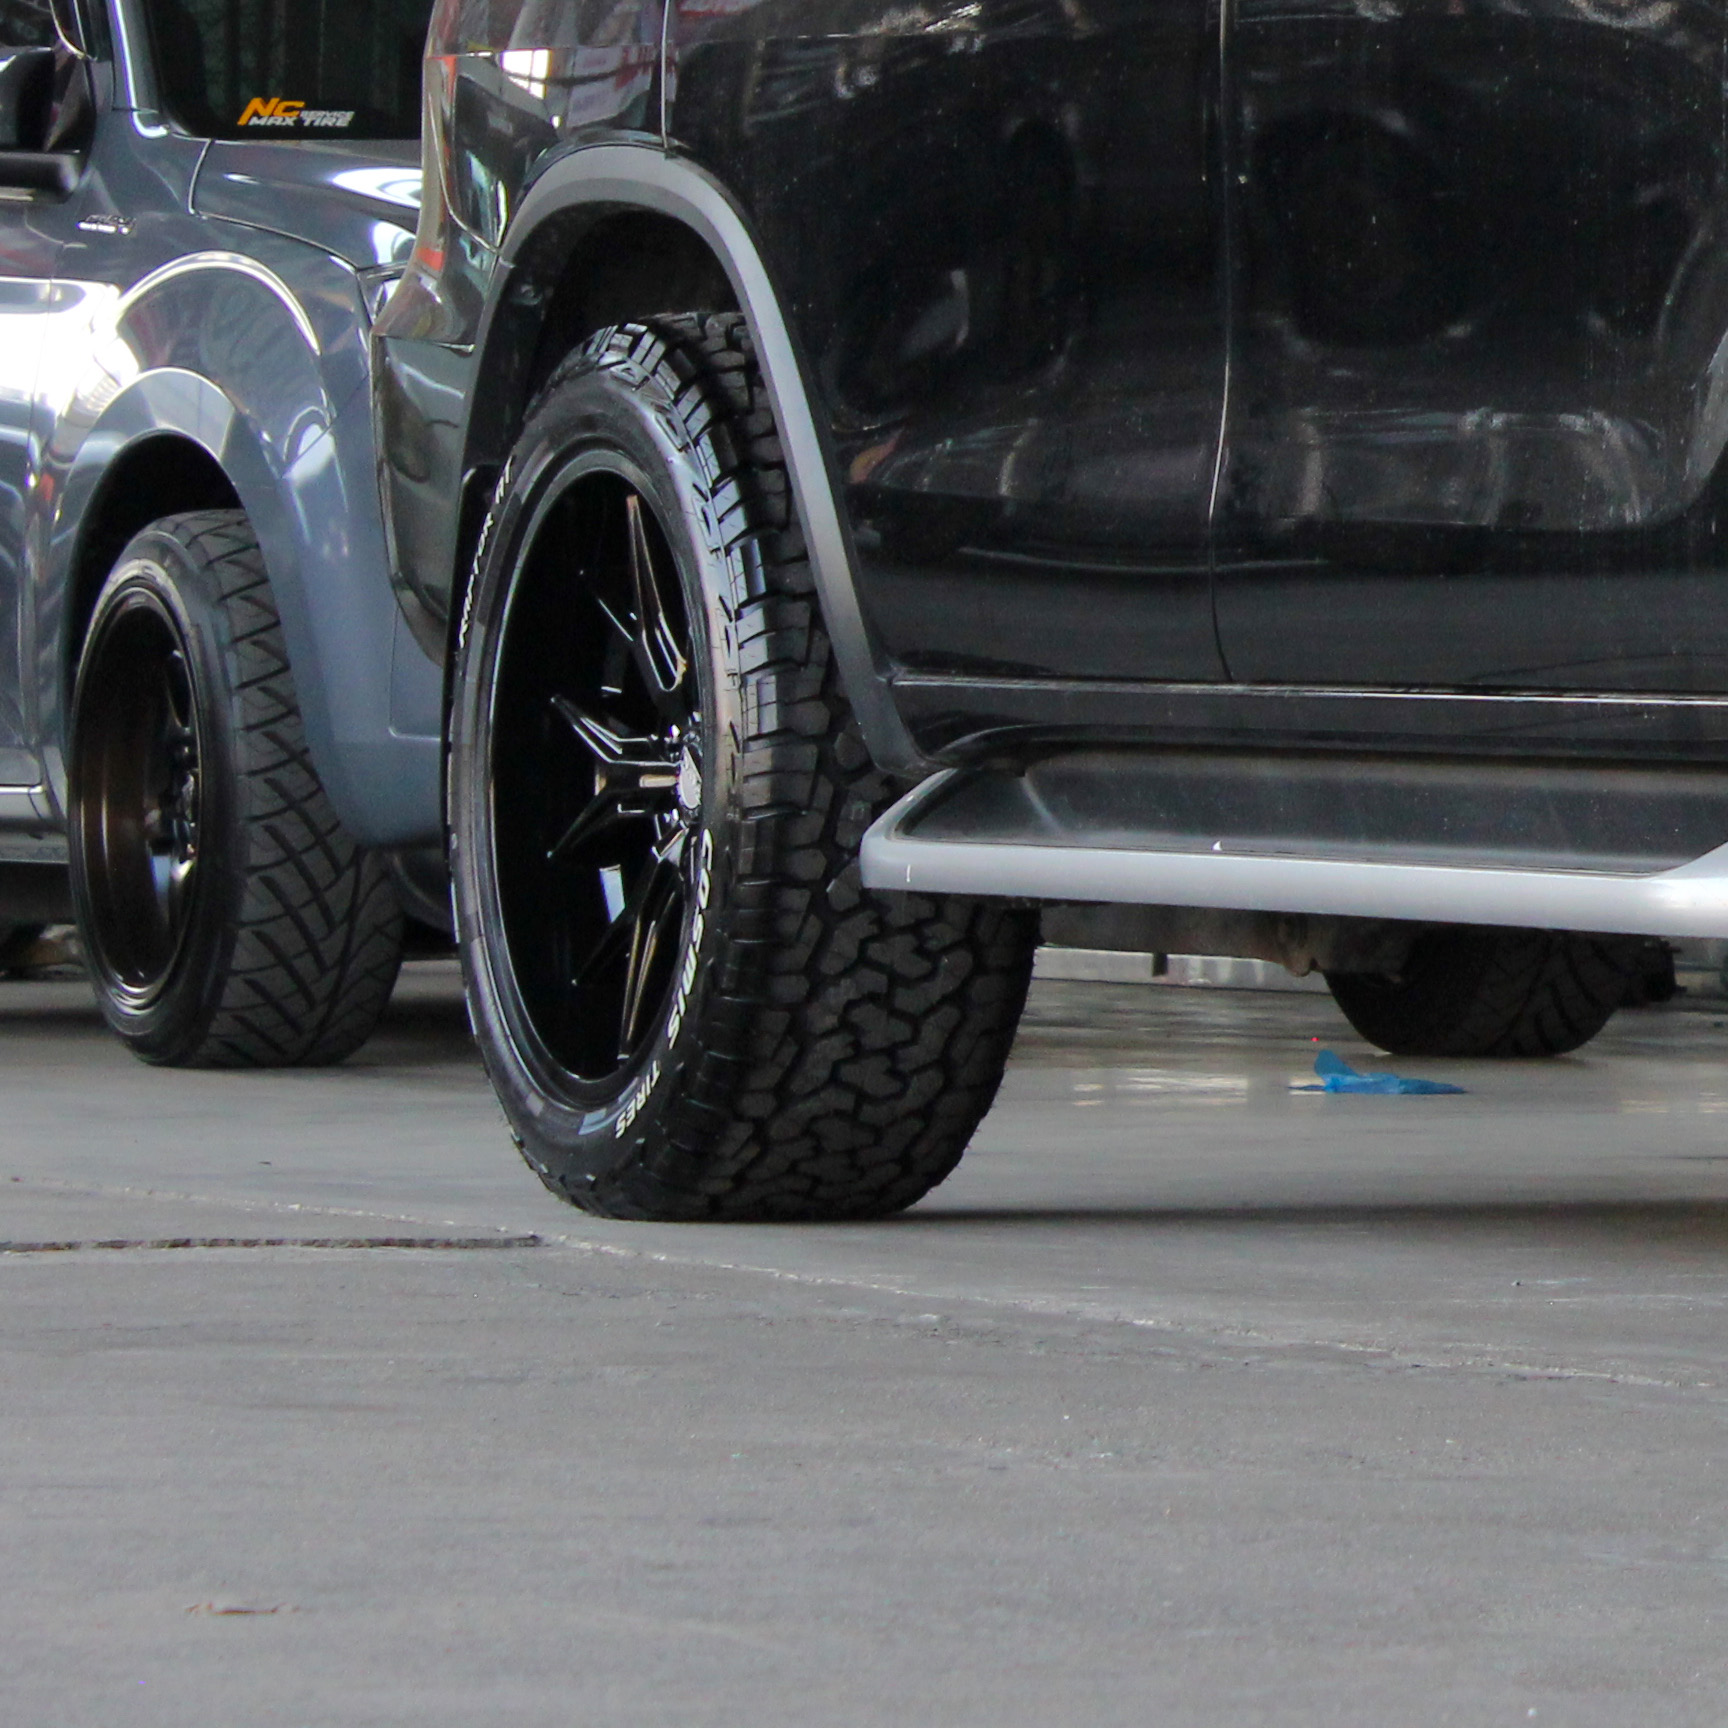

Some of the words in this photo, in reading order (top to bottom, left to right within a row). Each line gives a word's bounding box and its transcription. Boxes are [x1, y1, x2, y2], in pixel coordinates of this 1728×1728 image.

[237, 96, 306, 126] NC
[247, 116, 298, 127] MAX
[302, 116, 350, 127] TIRE
[667, 828, 714, 1050] COSMIS
[614, 1059, 661, 1140] TIRES
